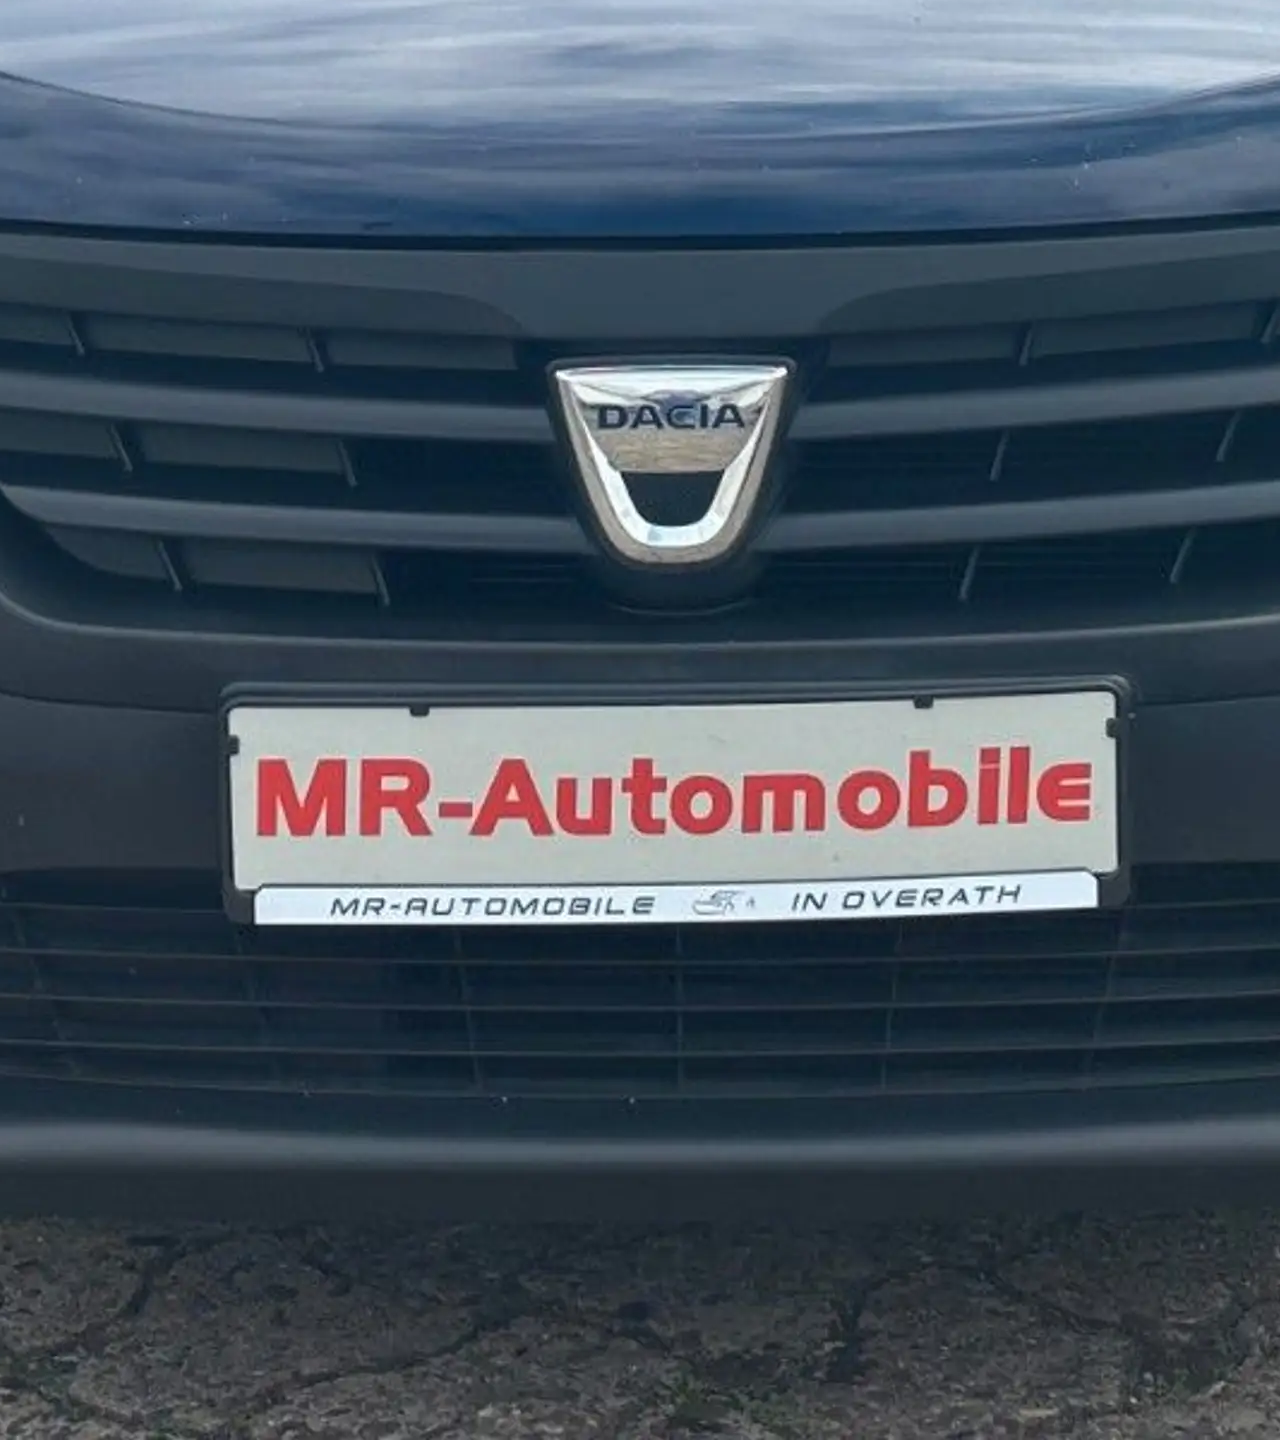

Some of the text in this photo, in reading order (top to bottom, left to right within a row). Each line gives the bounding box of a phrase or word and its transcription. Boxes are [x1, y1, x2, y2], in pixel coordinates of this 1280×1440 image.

[598, 404, 746, 430] DACIA
[256, 746, 1093, 837] MR-Automobile
[330, 883, 1022, 917] MR-AUTOMOBILE IN OVERATH
